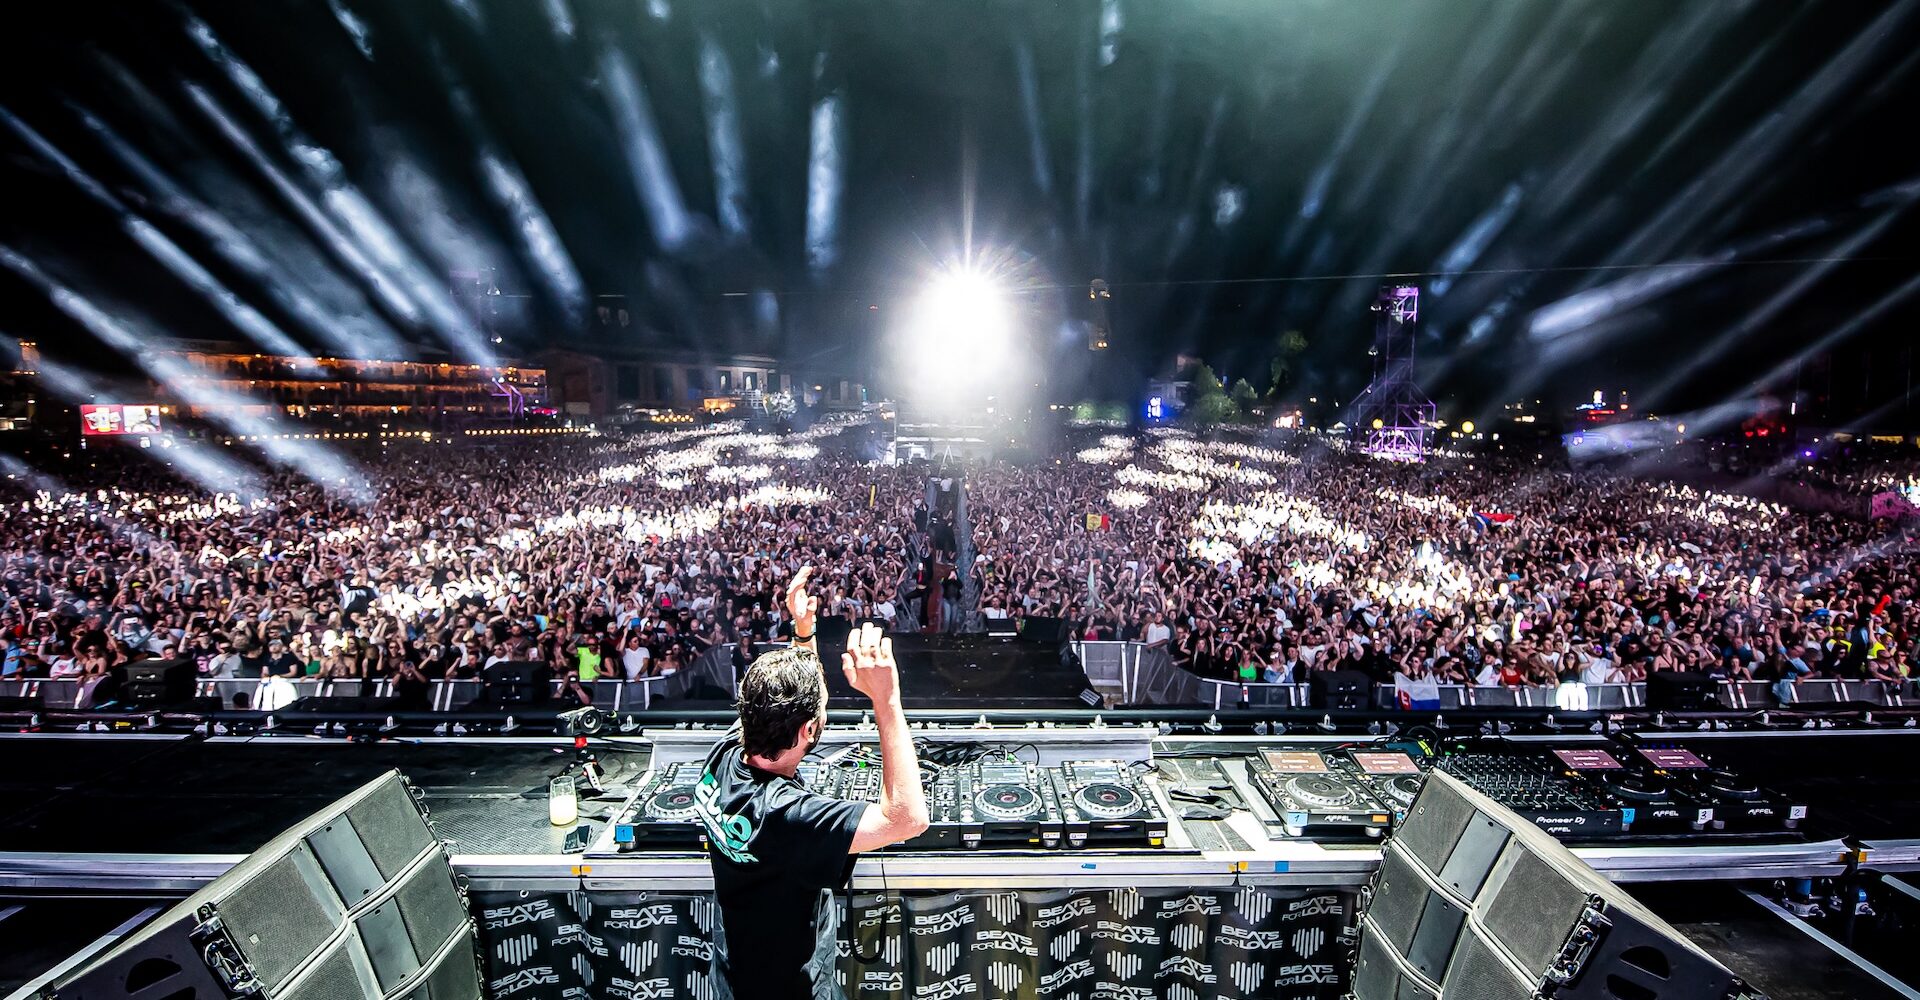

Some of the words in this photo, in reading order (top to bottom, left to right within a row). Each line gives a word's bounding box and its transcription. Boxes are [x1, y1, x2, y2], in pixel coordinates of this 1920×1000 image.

[1535, 816, 1574, 824] Pioneer
[483, 900, 549, 919] BEATS
[1038, 897, 1092, 918] BEATS
[1163, 895, 1217, 909] BEATS
[1289, 896, 1338, 911] BEATS
[610, 904, 673, 919] BEATS
[914, 905, 970, 925] BEATS
[1097, 921, 1155, 936] BEATS
[1221, 925, 1280, 940] BEATS
[976, 930, 1033, 946] BEATS
[1160, 956, 1212, 973] BEATS
[1280, 965, 1334, 976] BEATS
[490, 967, 553, 990] BEATS
[1041, 960, 1090, 985] BEATS
[611, 977, 669, 991] BEATS
[916, 974, 971, 995] BEATS
[1096, 982, 1153, 996] BEATS
